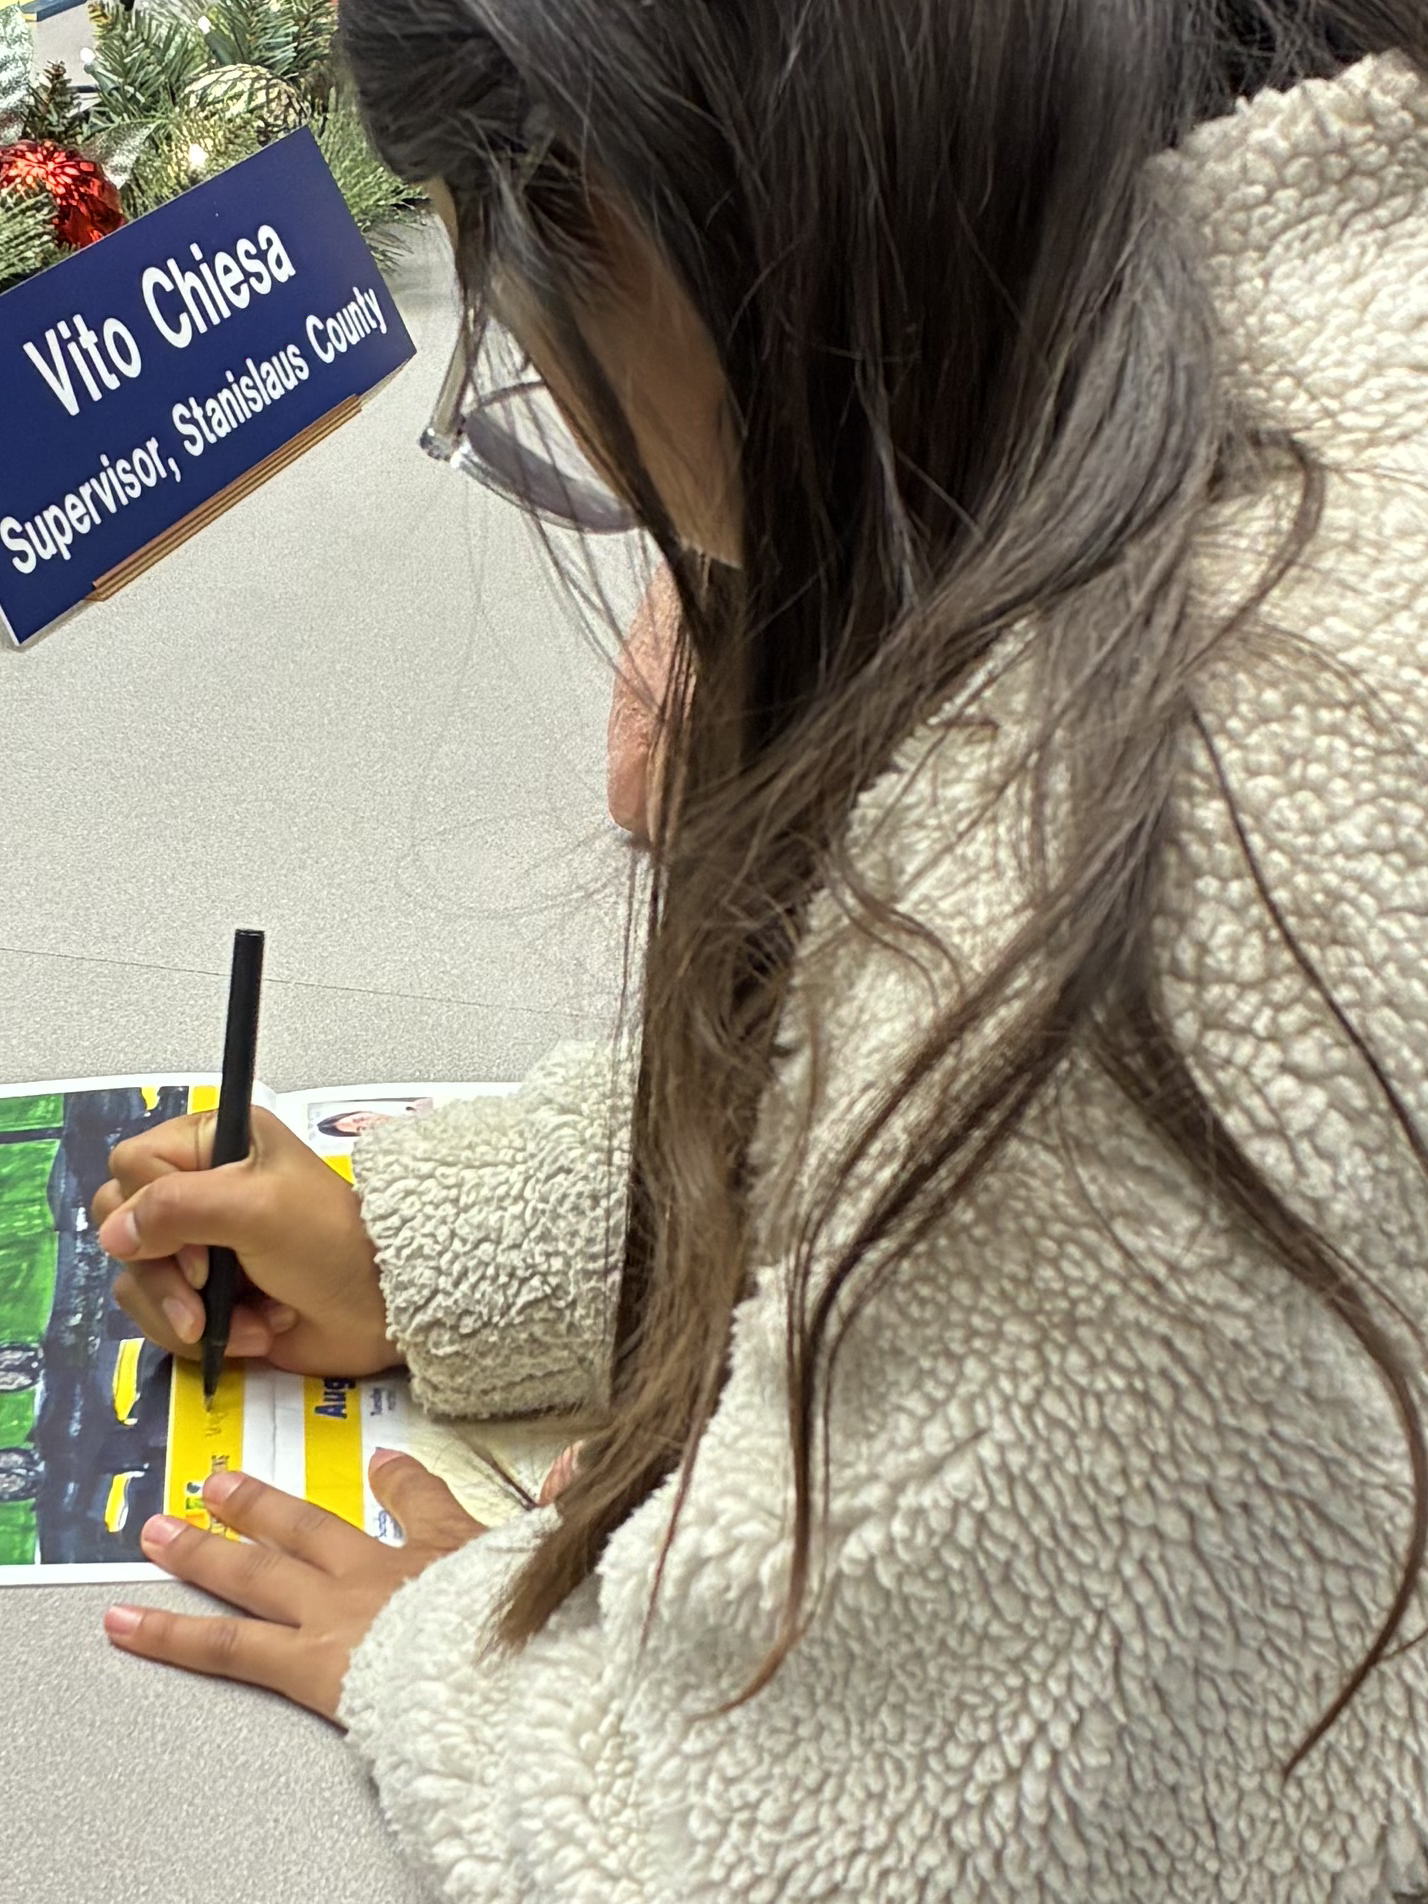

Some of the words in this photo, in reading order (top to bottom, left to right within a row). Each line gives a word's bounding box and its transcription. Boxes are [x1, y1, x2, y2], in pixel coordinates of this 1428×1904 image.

[23, 313, 142, 416] Vito
[141, 224, 297, 349] Chiesa
[0, 436, 182, 574] Supervisor,
[171, 343, 310, 457] Stanislaus
[305, 286, 388, 364] County
[314, 1377, 356, 1420] Aug
